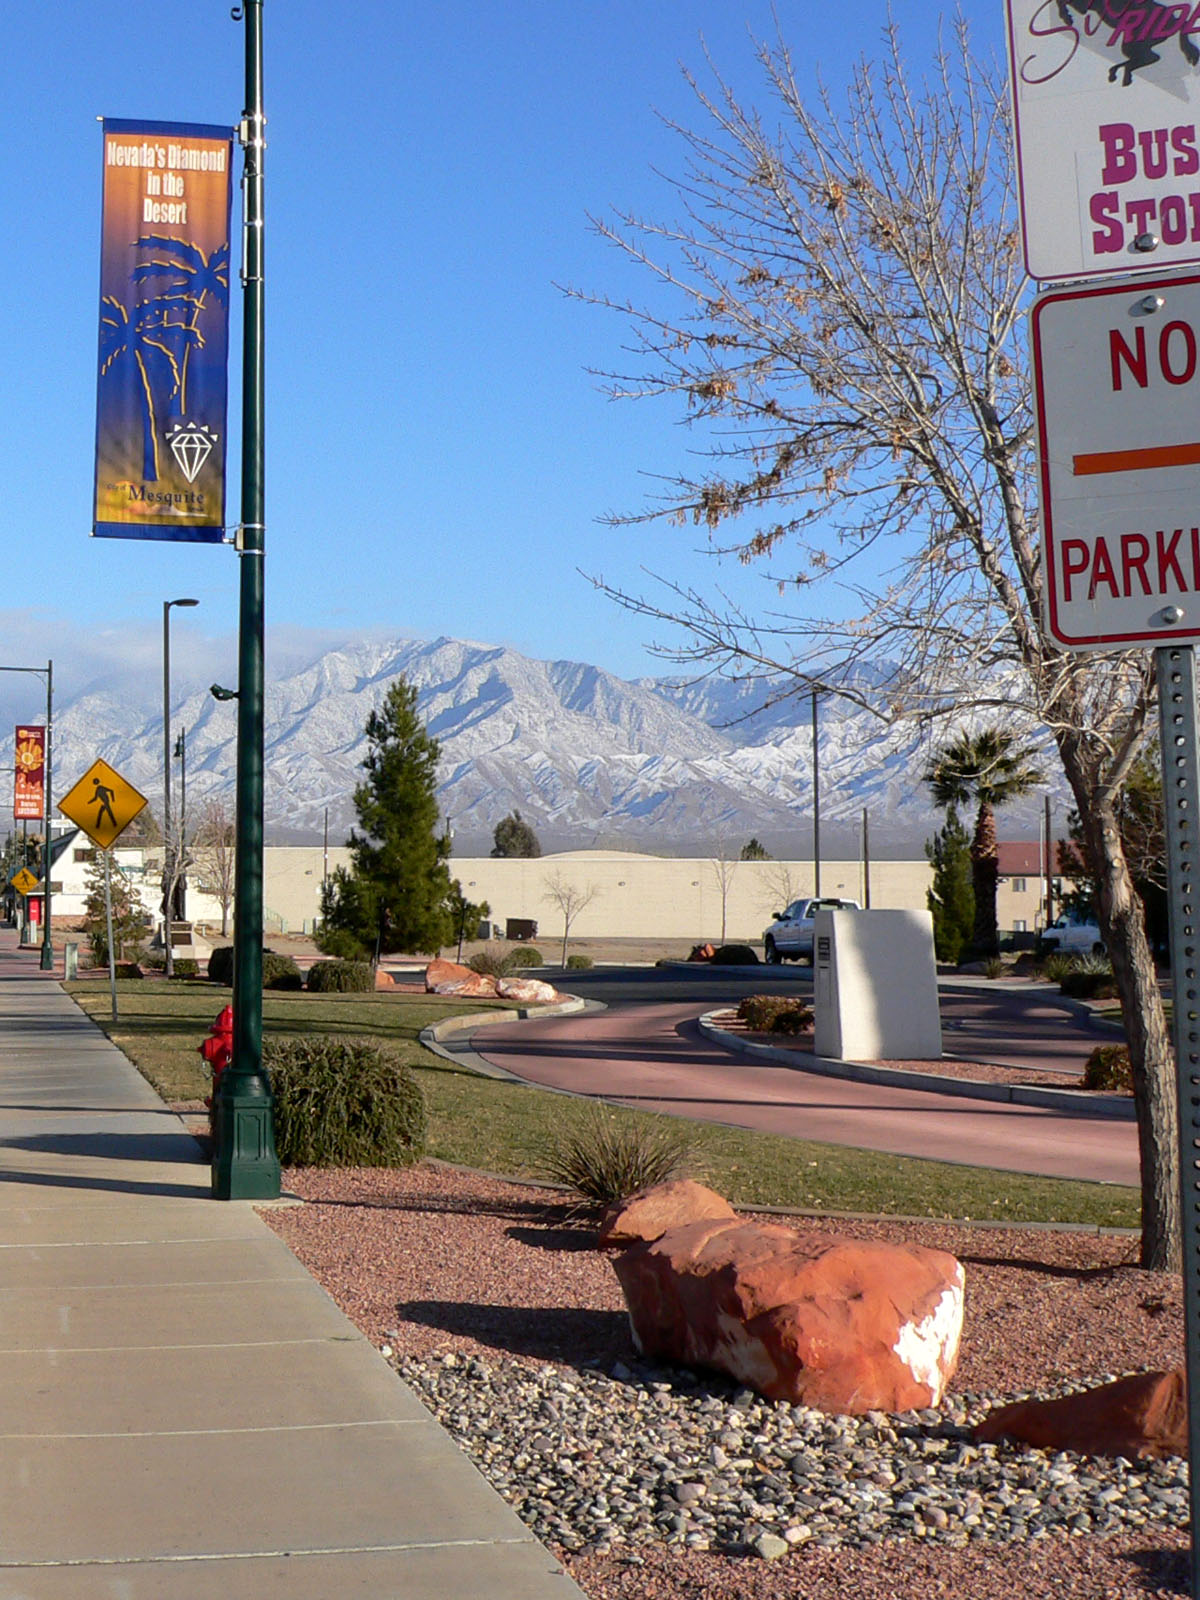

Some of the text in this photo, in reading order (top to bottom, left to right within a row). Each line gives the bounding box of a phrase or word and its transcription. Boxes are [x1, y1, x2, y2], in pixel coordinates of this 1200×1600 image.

[107, 141, 226, 172] Nevada's Diamond
[147, 170, 184, 197] in the
[143, 198, 187, 224] Desert
[1109, 320, 1197, 391] NO
[128, 484, 205, 507] Mesquite
